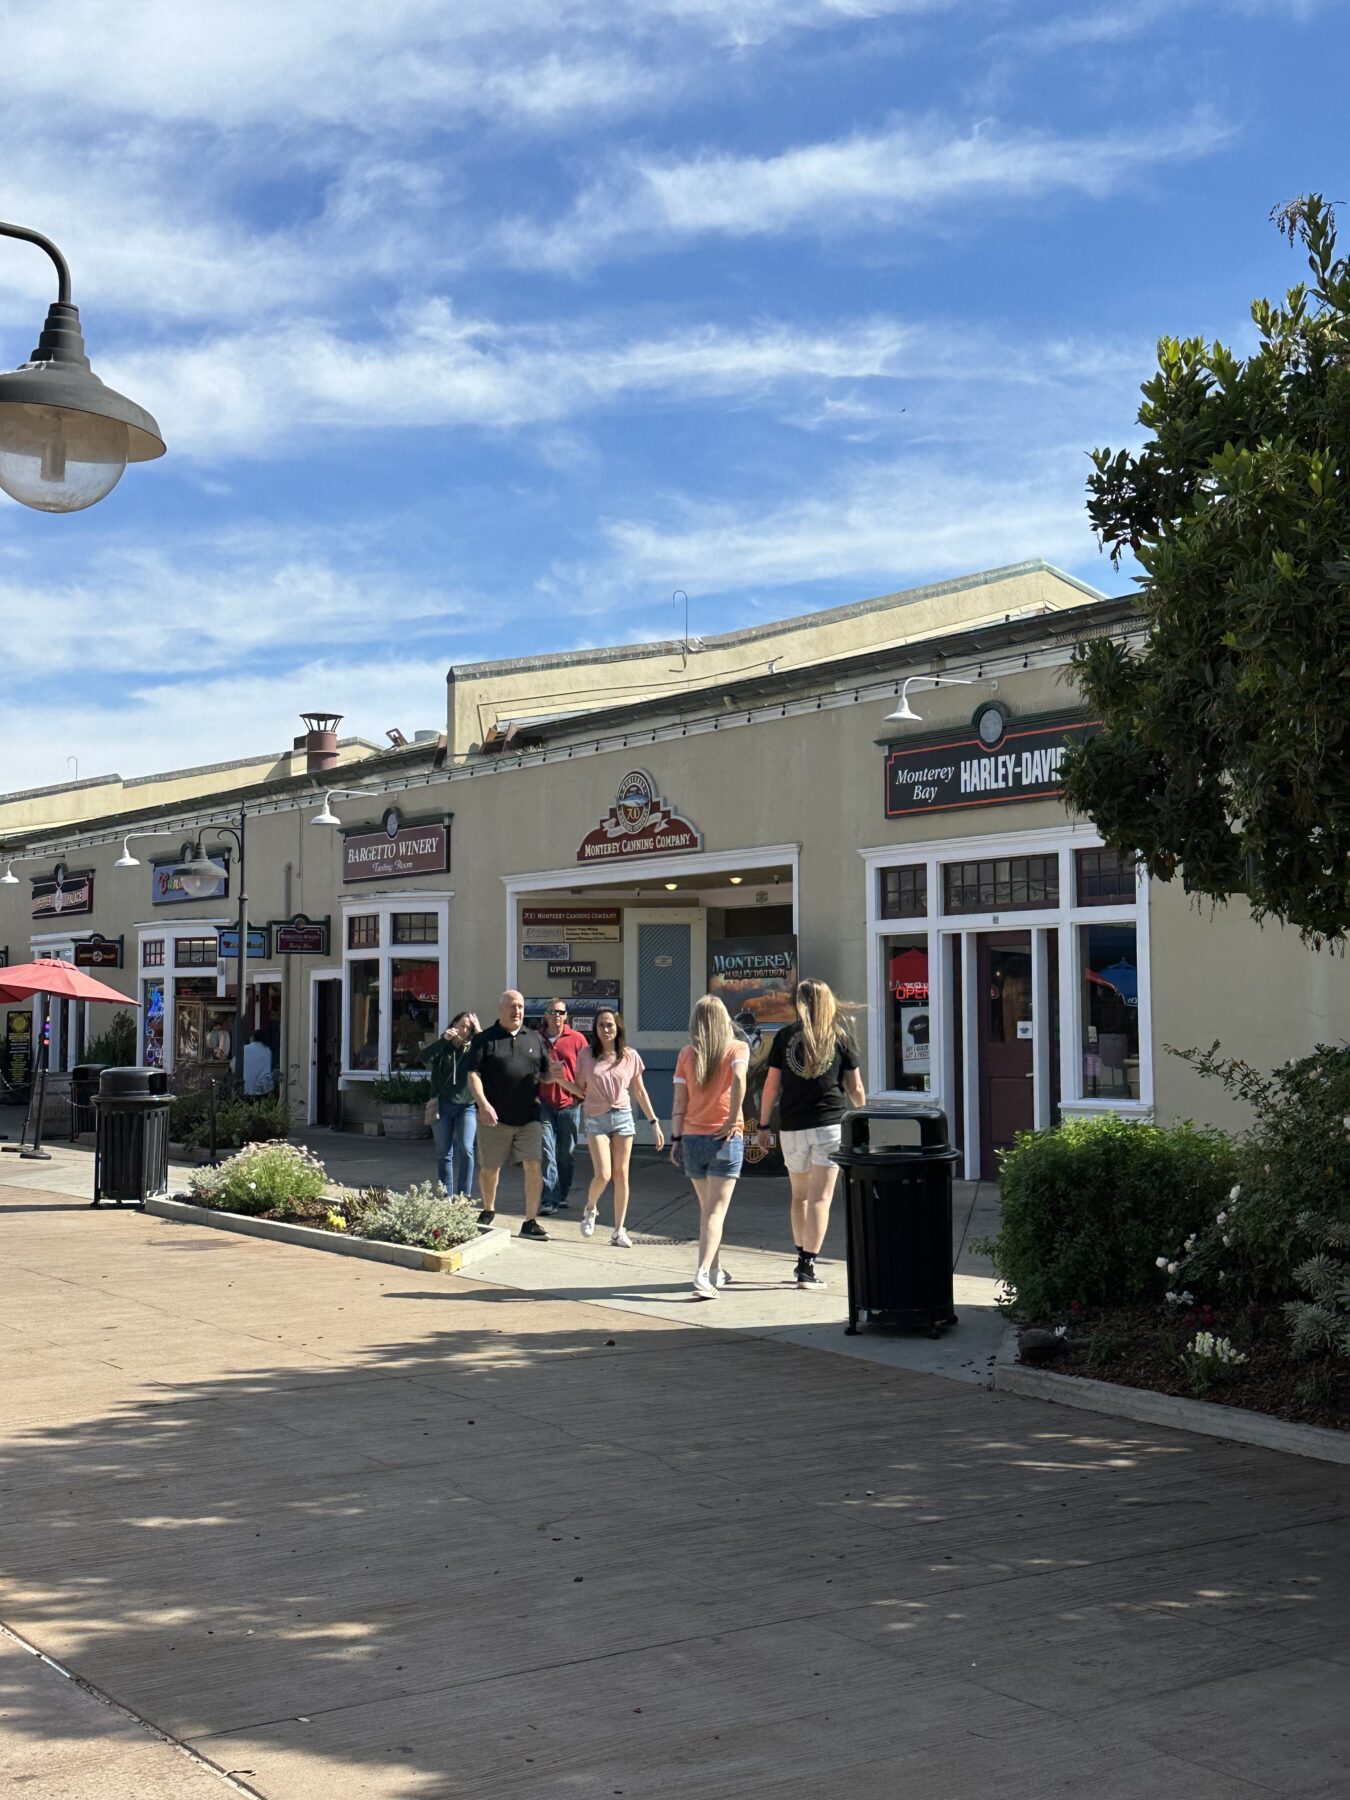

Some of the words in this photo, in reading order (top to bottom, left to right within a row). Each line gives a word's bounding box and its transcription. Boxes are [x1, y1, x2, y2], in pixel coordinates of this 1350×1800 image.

[895, 766, 955, 785] Monterey
[912, 785, 938, 803] Bay
[348, 843, 396, 864] BARGETTO
[398, 837, 439, 856] WINERY
[584, 842, 621, 857] MONTEREY
[621, 838, 655, 852] CANNING
[655, 833, 691, 848] COMPANY
[394, 859, 413, 870] Room
[537, 912, 565, 920] MONTEREY
[711, 951, 793, 974] MONTEREY
